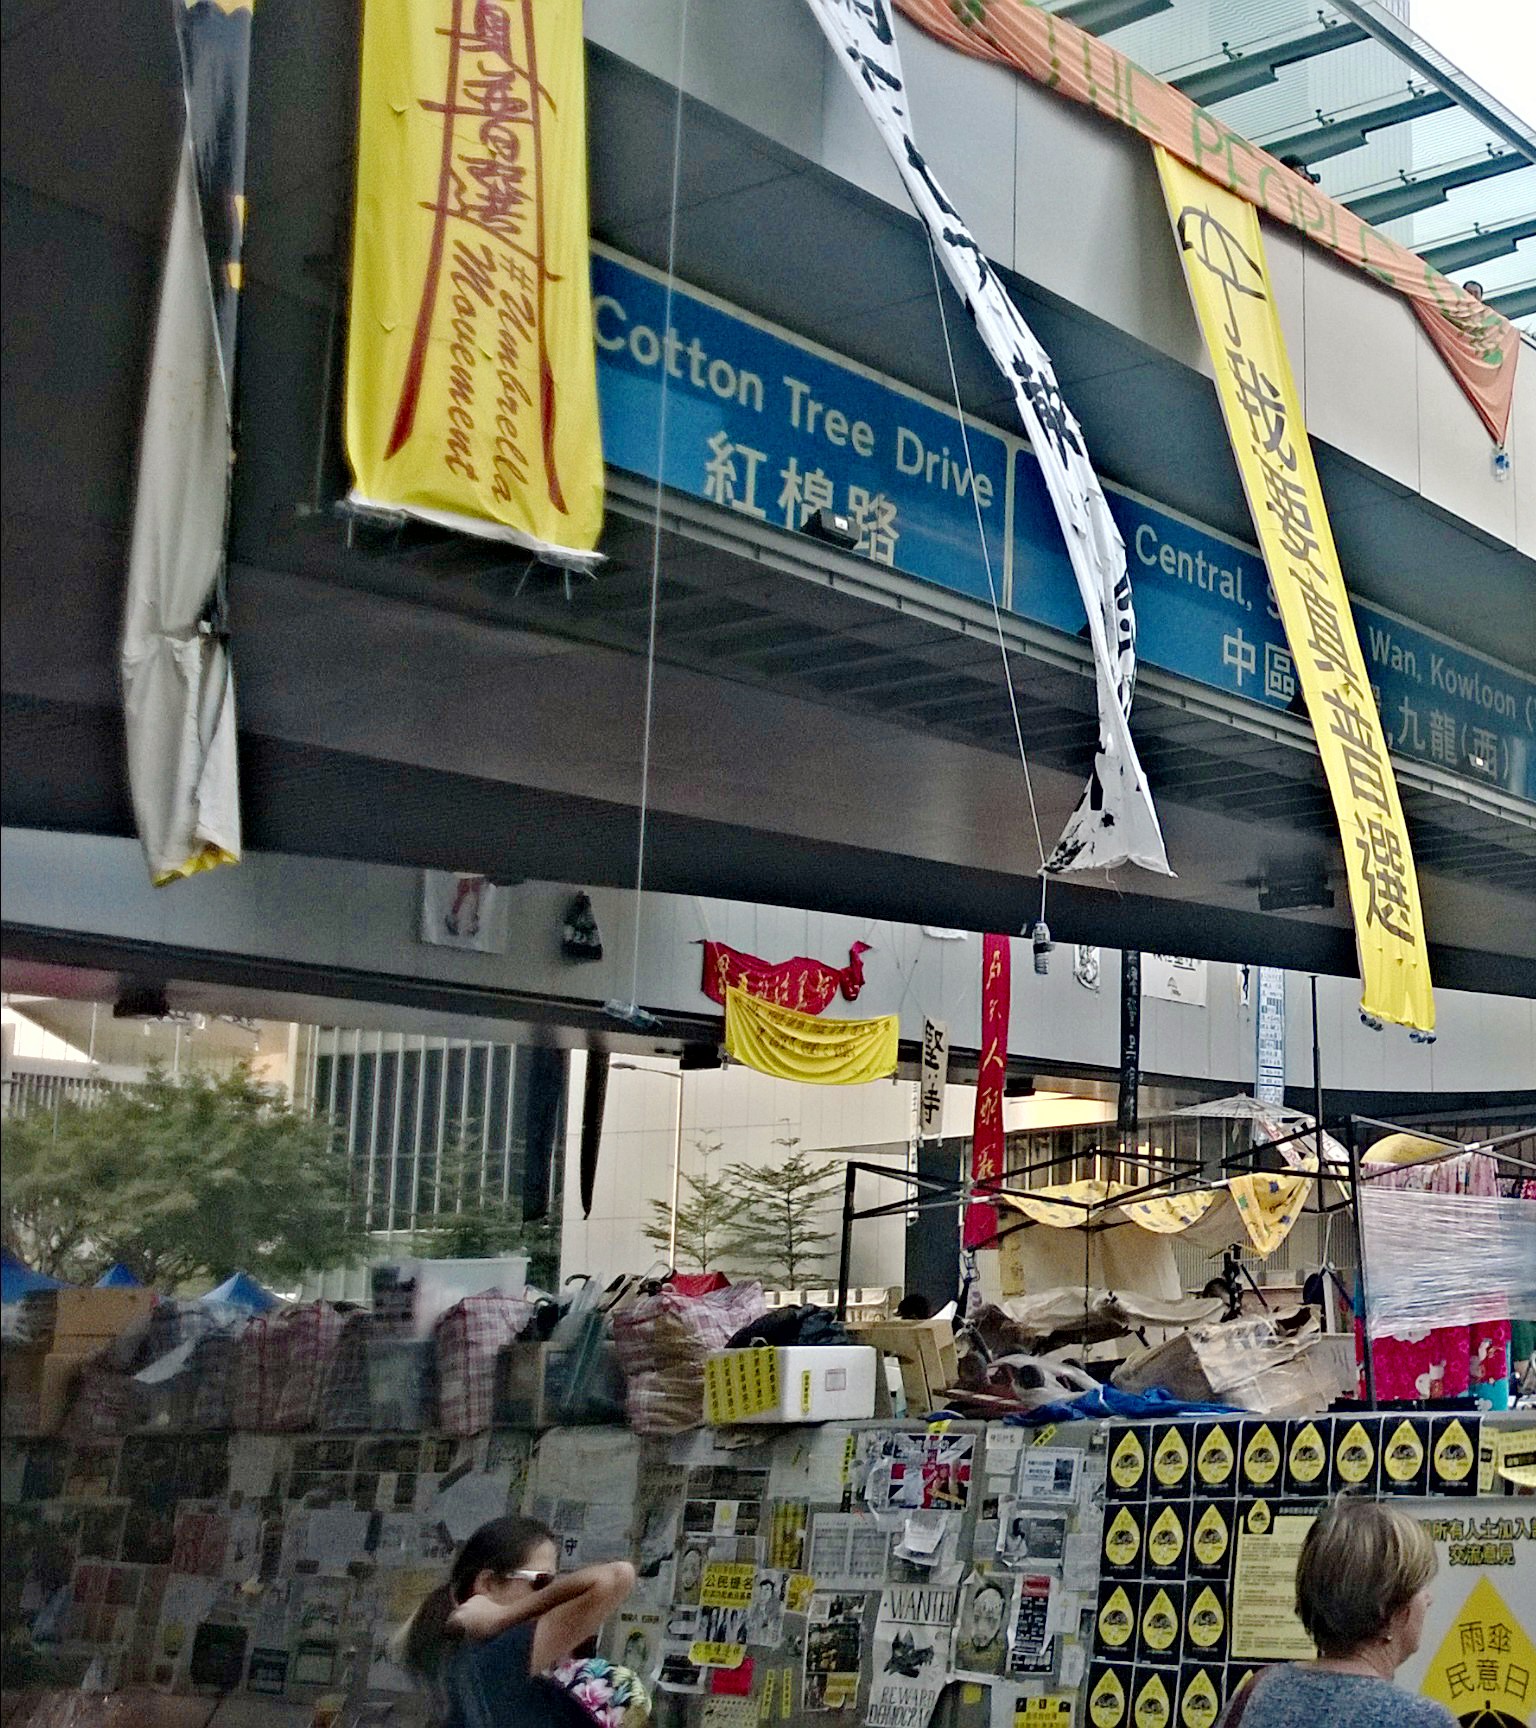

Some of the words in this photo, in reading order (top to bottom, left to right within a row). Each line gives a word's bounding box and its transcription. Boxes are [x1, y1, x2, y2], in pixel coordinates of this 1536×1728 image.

[444, 239, 498, 482] Movement
[491, 252, 537, 504] #Umbrella
[594, 295, 763, 413] Cotton
[783, 376, 876, 457] Tree
[896, 427, 994, 508] Drive
[703, 430, 900, 568] 紅棉路
[1135, 523, 1253, 612] Central,
[1369, 625, 1423, 684] Wan,
[1430, 653, 1516, 719] Kowloon
[1222, 627, 1296, 703] 中區
[1224, 346, 1417, 948] 我要真普選
[1448, 1542, 1516, 1566] 交流意見
[1445, 1659, 1530, 1702] 民意日
[1458, 1620, 1513, 1656] 雨傘
